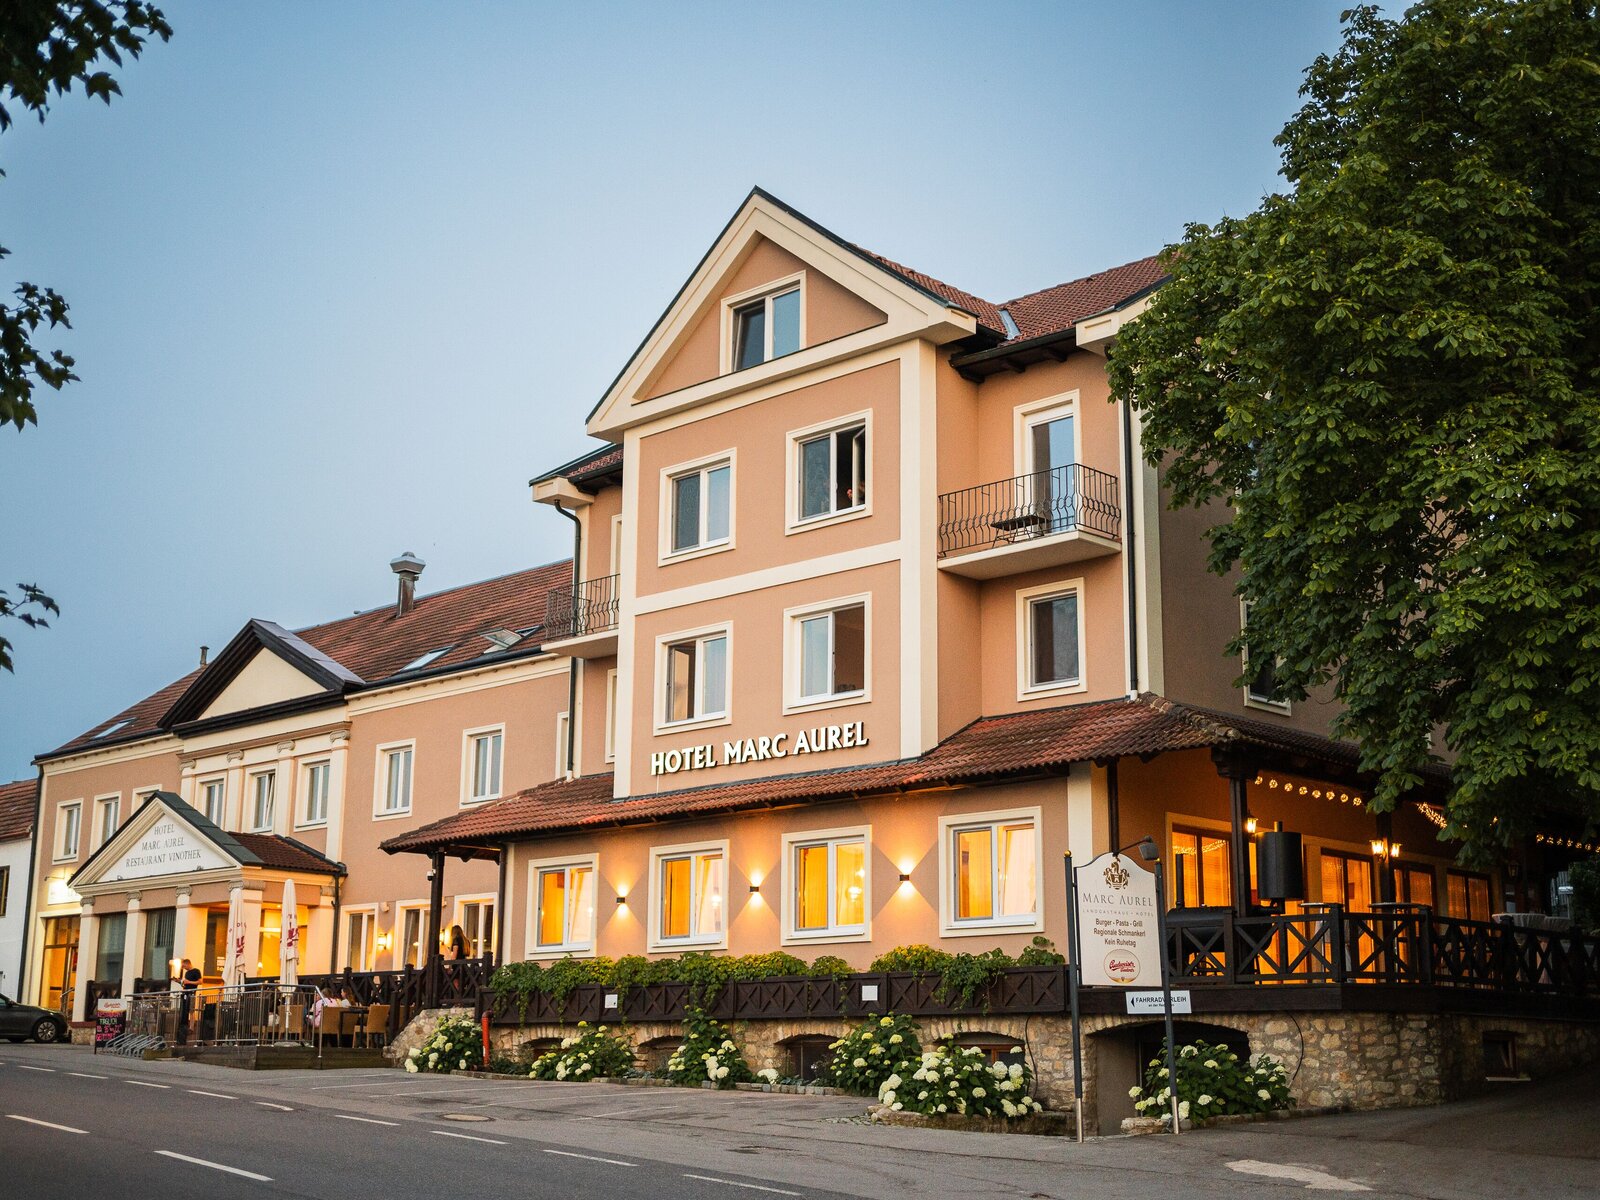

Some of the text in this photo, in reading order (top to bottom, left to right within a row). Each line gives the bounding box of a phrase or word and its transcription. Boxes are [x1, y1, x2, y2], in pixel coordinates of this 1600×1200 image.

[651, 721, 869, 776] HOTEL MARC AUREL
[154, 824, 175, 835] HOTEL
[142, 837, 184, 851] MARC AUREL
[126, 849, 201, 867] RESTAURANT VINOTHEK
[1083, 893, 1153, 906] MARC AUREL
[1095, 918, 1112, 927] Burger
[1094, 928, 1146, 937] Regionale Schmankerl
[1117, 939, 1136, 947] Ruhetag
